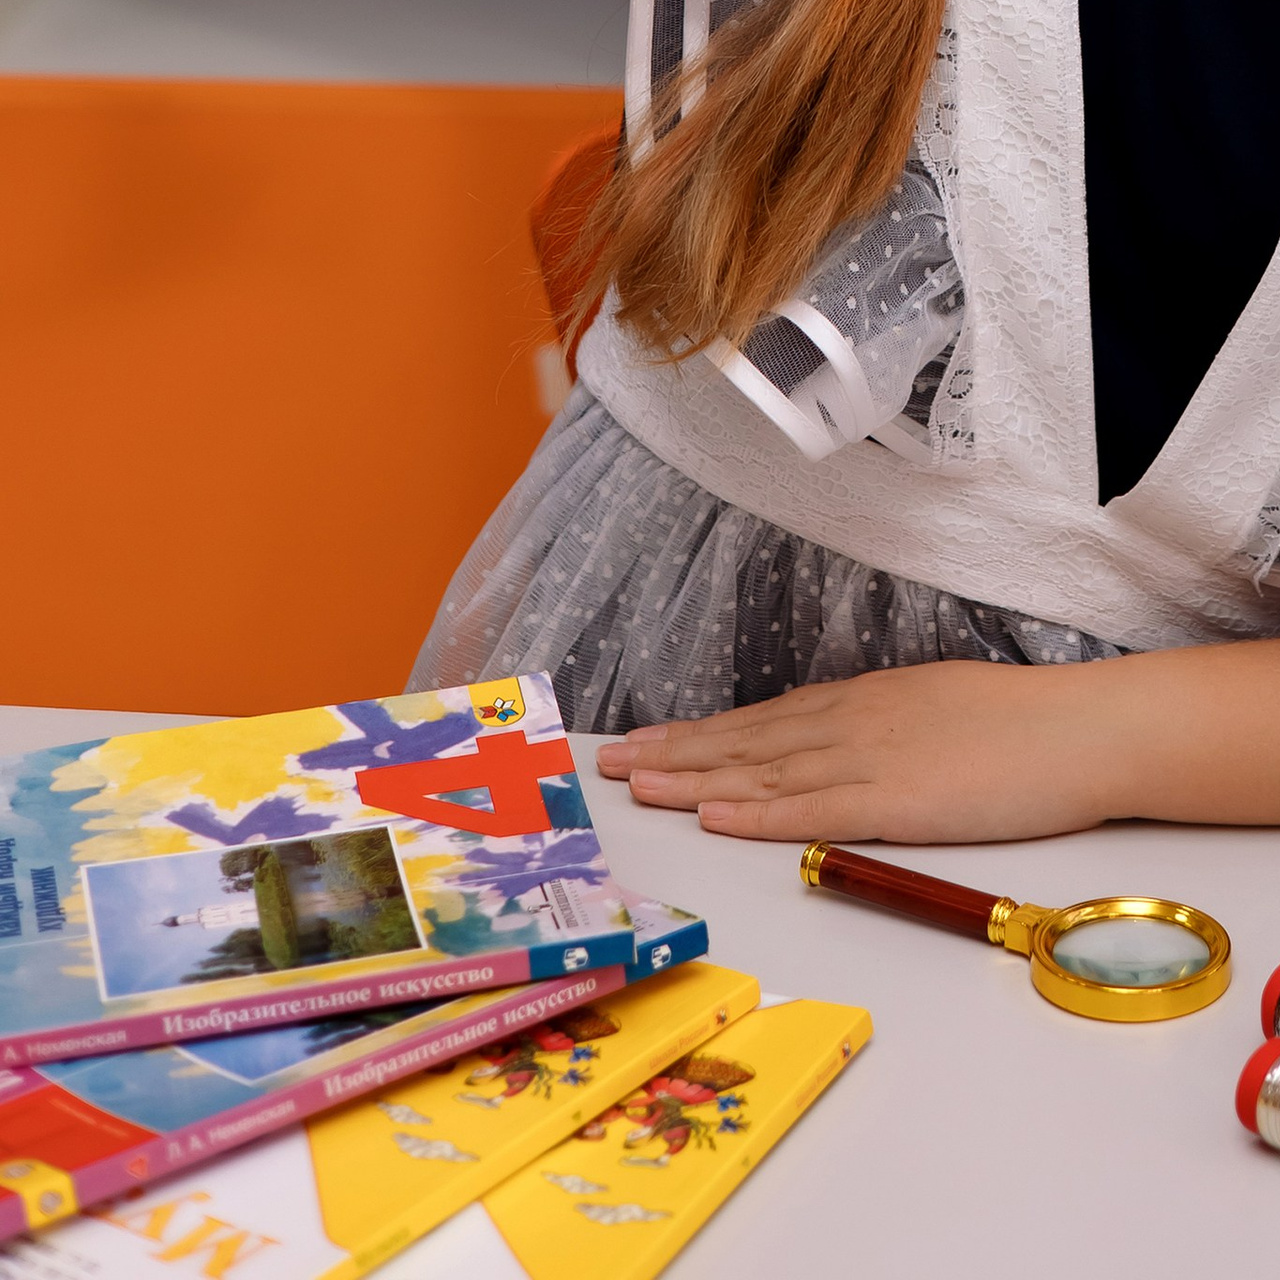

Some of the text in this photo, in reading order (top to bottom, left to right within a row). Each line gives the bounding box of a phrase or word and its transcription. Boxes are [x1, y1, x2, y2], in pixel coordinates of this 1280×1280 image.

[354, 729, 575, 837] 4
[30, 865, 66, 933] художник
[162, 986, 372, 1035] Изобразительное
[379, 964, 494, 1001] искусство
[322, 1013, 497, 1098] Изобразительное
[502, 977, 597, 1026] искусство
